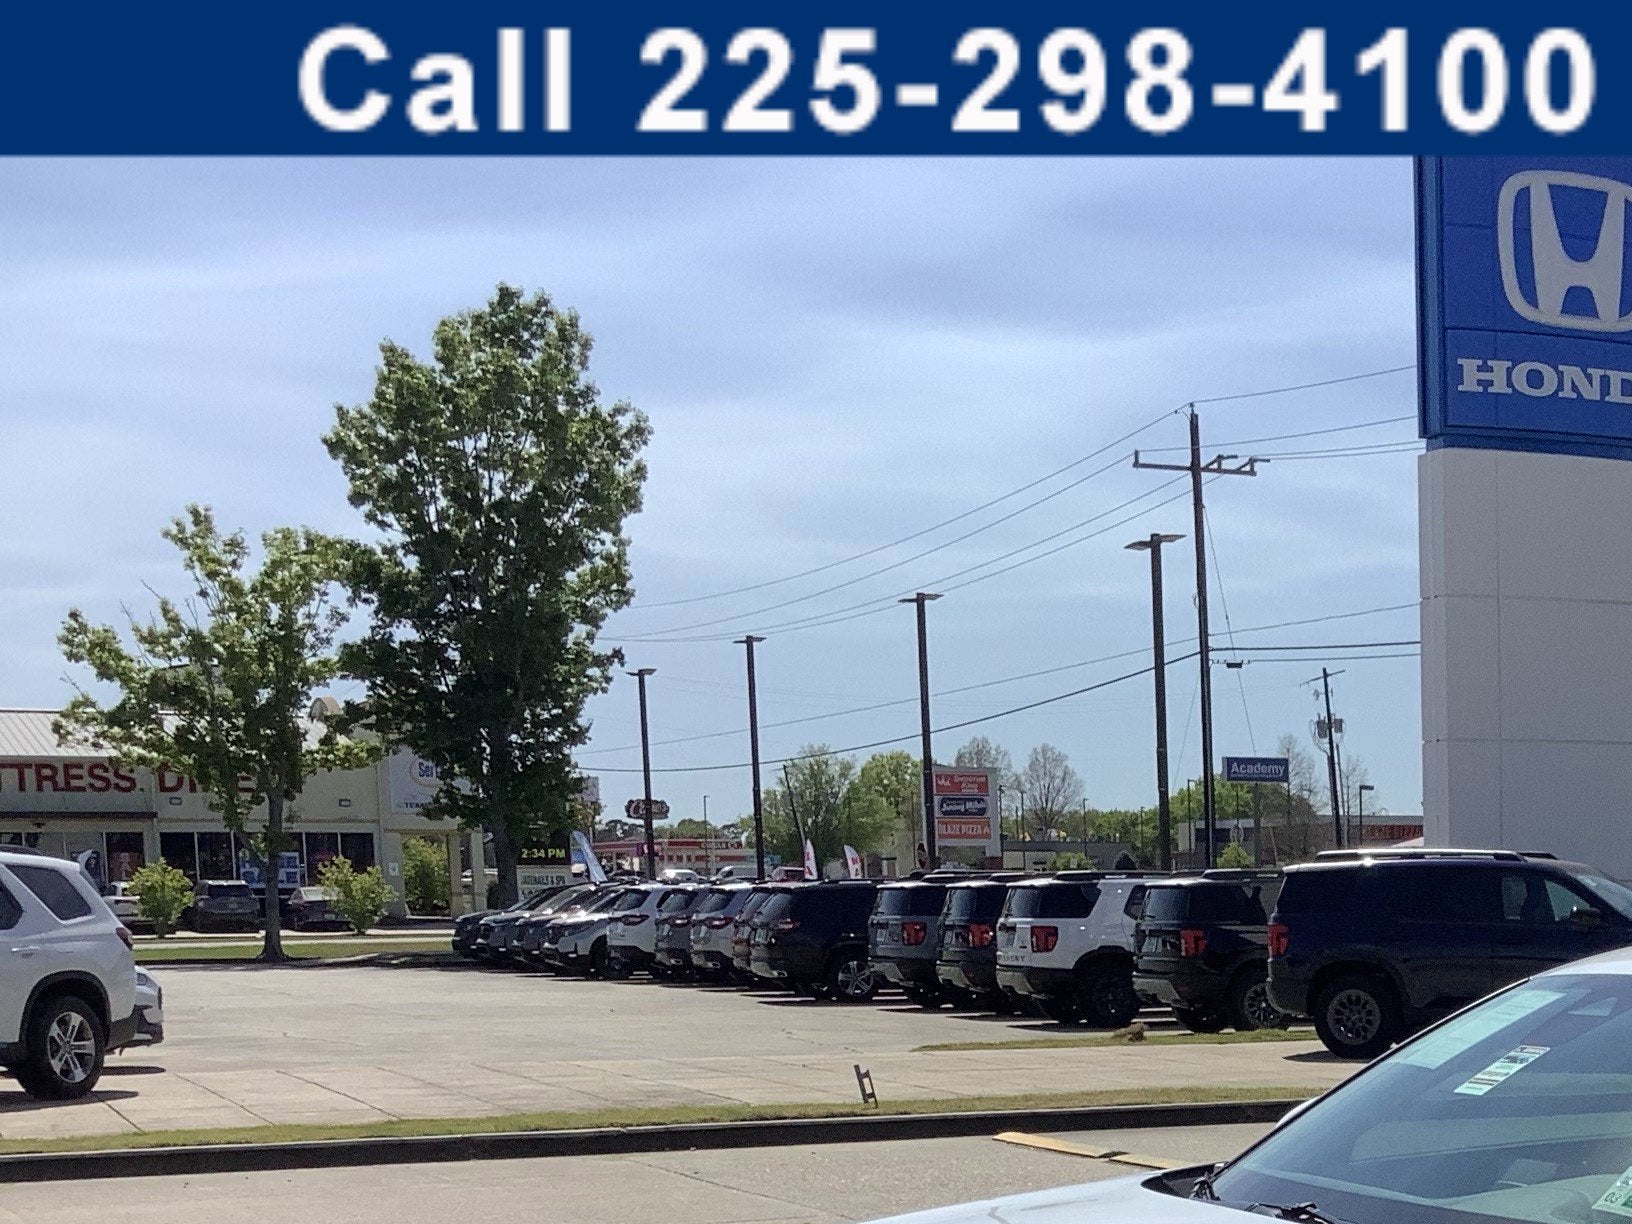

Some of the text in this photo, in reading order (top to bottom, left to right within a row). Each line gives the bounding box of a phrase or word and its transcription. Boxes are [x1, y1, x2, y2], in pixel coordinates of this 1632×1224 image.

[1230, 762, 1285, 777] Academy
[521, 848, 566, 858] 2:34 PM
